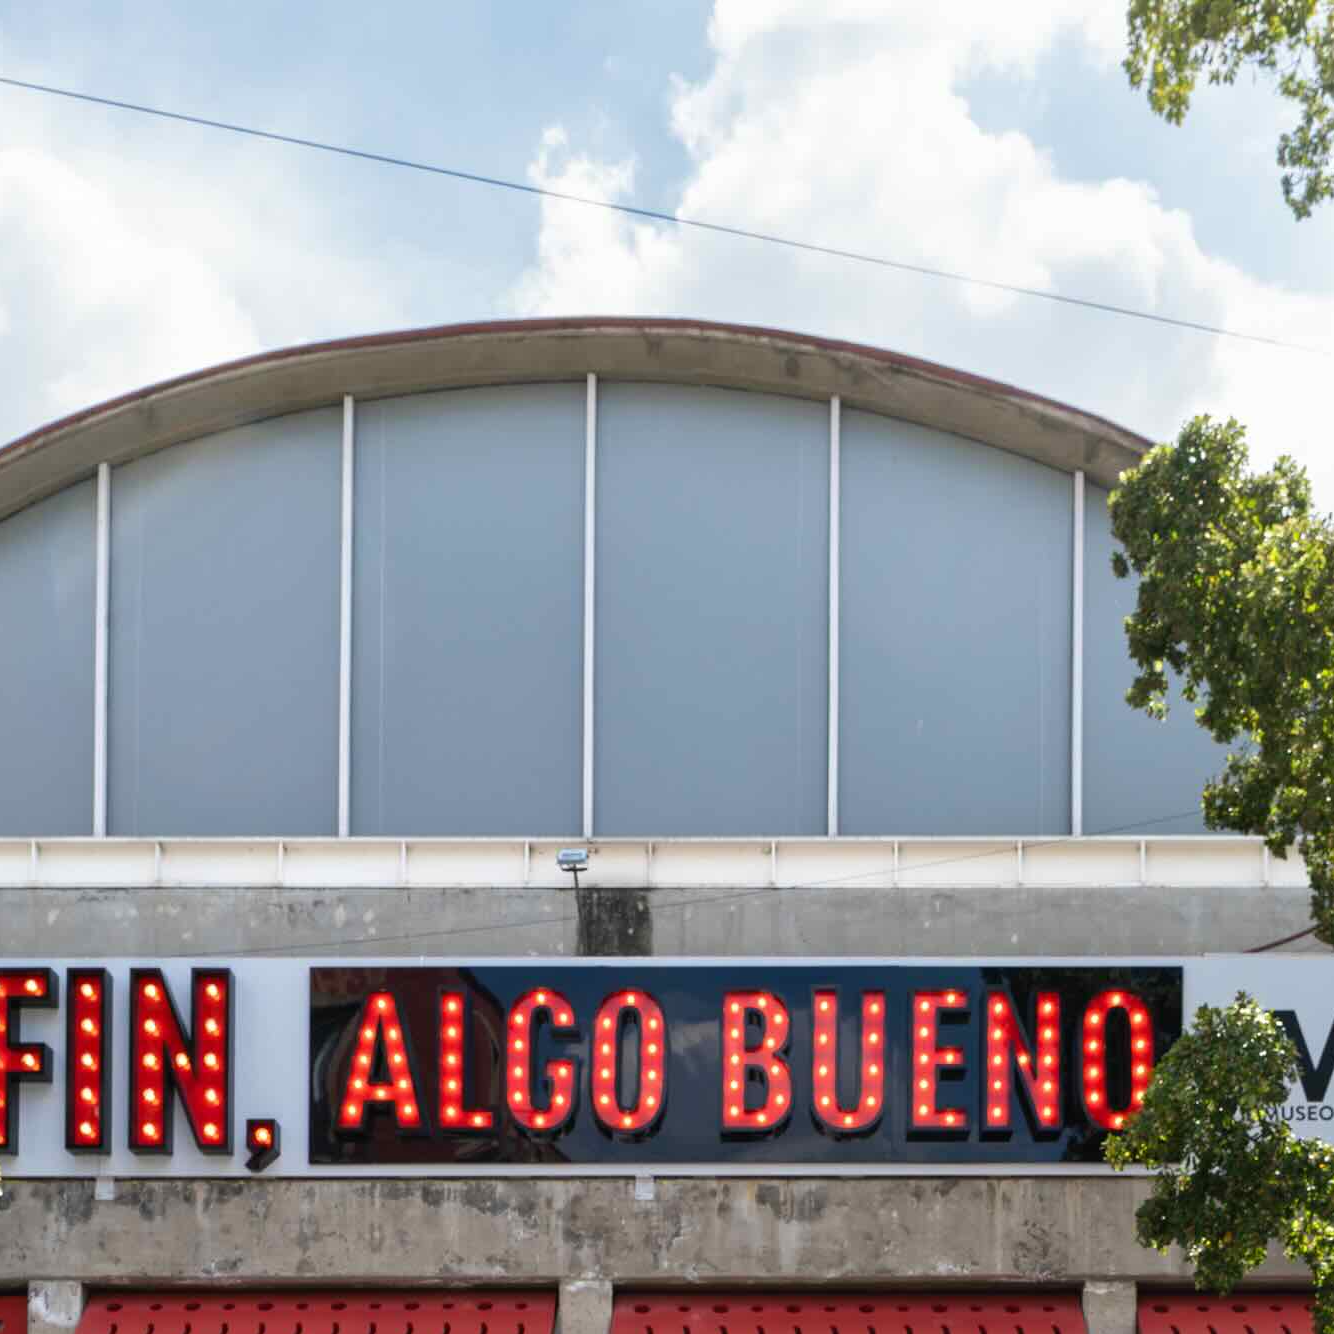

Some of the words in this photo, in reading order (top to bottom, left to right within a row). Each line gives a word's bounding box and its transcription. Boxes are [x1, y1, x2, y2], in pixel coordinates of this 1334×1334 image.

[335, 986, 667, 1139] ALGO
[720, 985, 1156, 1139] BUENO
[1266, 1105, 1334, 1121] MUSEO
